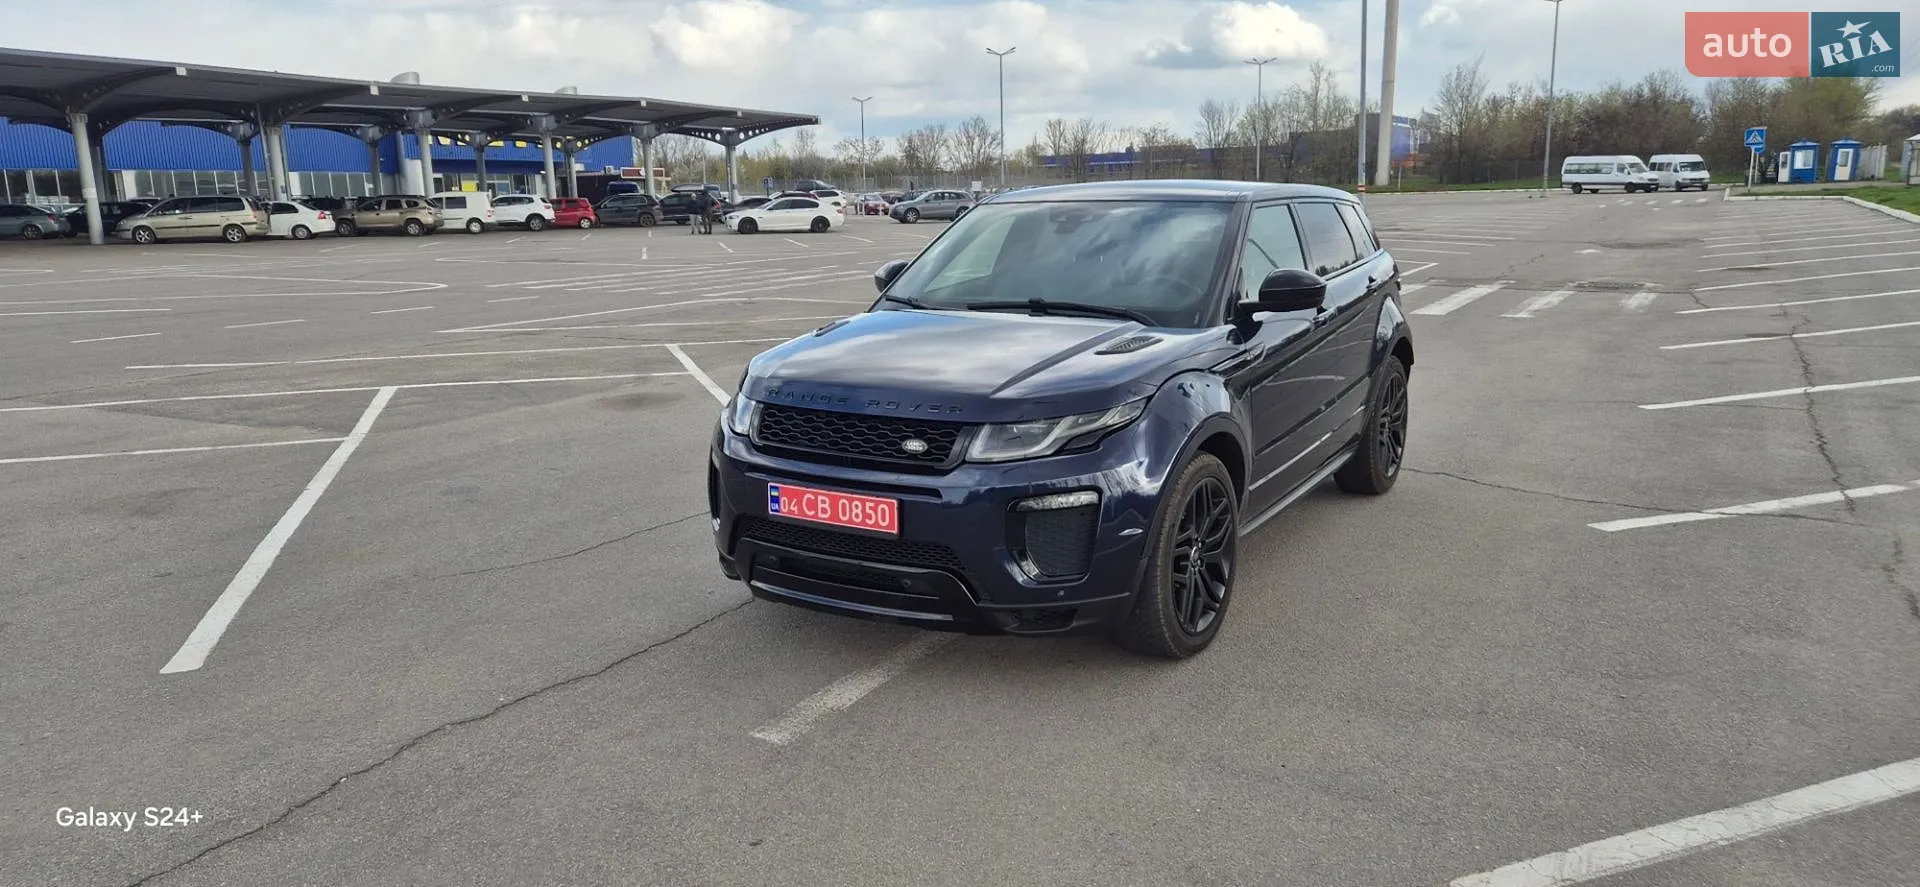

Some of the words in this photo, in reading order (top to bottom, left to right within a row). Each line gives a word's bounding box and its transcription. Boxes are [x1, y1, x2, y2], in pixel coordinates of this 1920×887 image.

[766, 388, 849, 405] RANGE
[865, 401, 962, 413] ROVER
[780, 497, 798, 514] 04
[802, 493, 831, 518] CB
[838, 499, 890, 527] 0850
